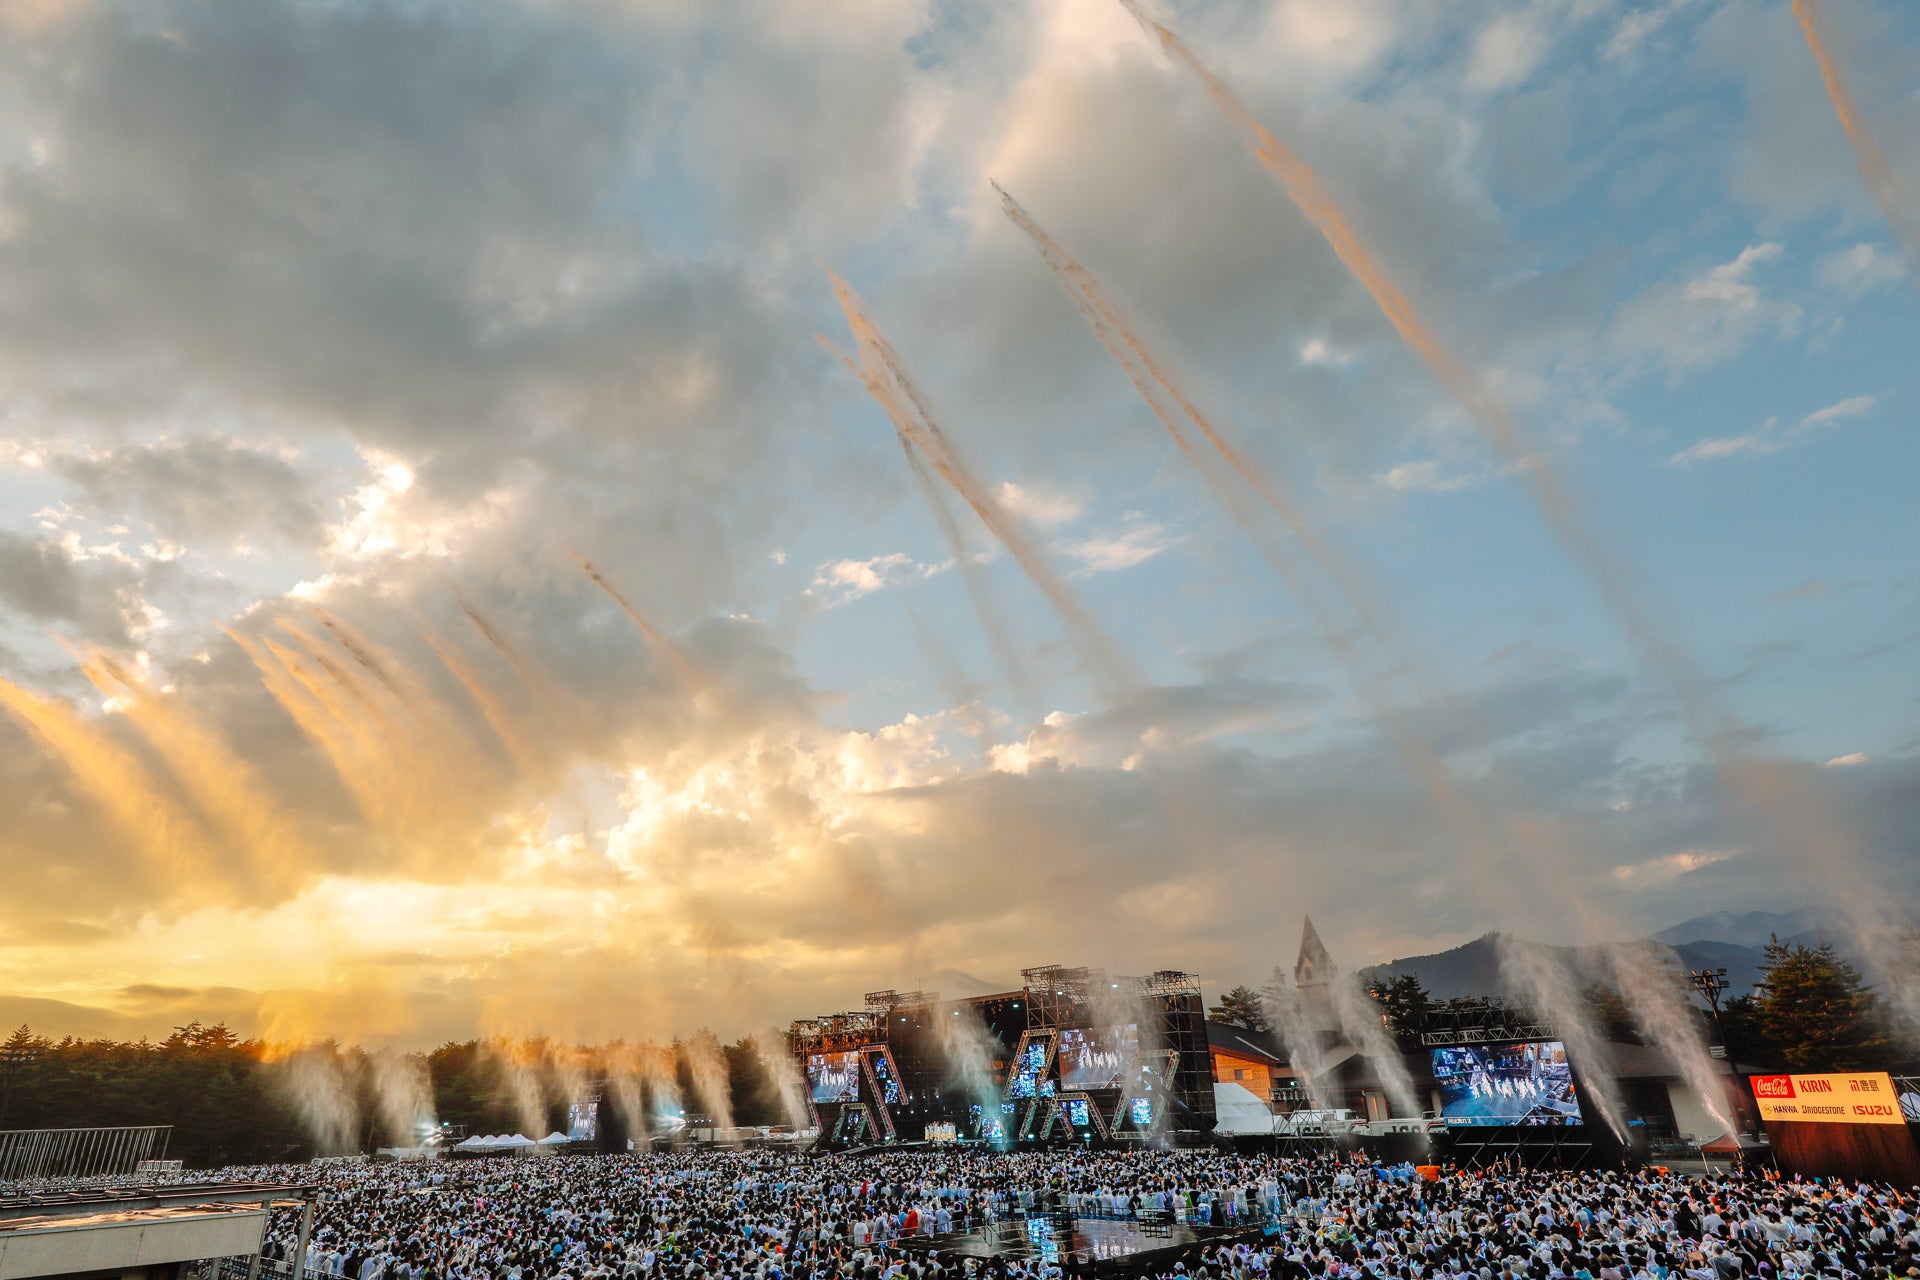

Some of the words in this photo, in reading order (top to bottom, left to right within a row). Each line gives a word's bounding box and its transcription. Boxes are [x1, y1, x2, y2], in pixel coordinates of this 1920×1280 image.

[1799, 1079, 1832, 1093] KIRIN
[1859, 1079, 1880, 1092] 鹿島
[1772, 1105, 1799, 1114] HANWA
[1802, 1104, 1846, 1115] BRIDGESTONE
[1852, 1105, 1893, 1116] ISUZU
